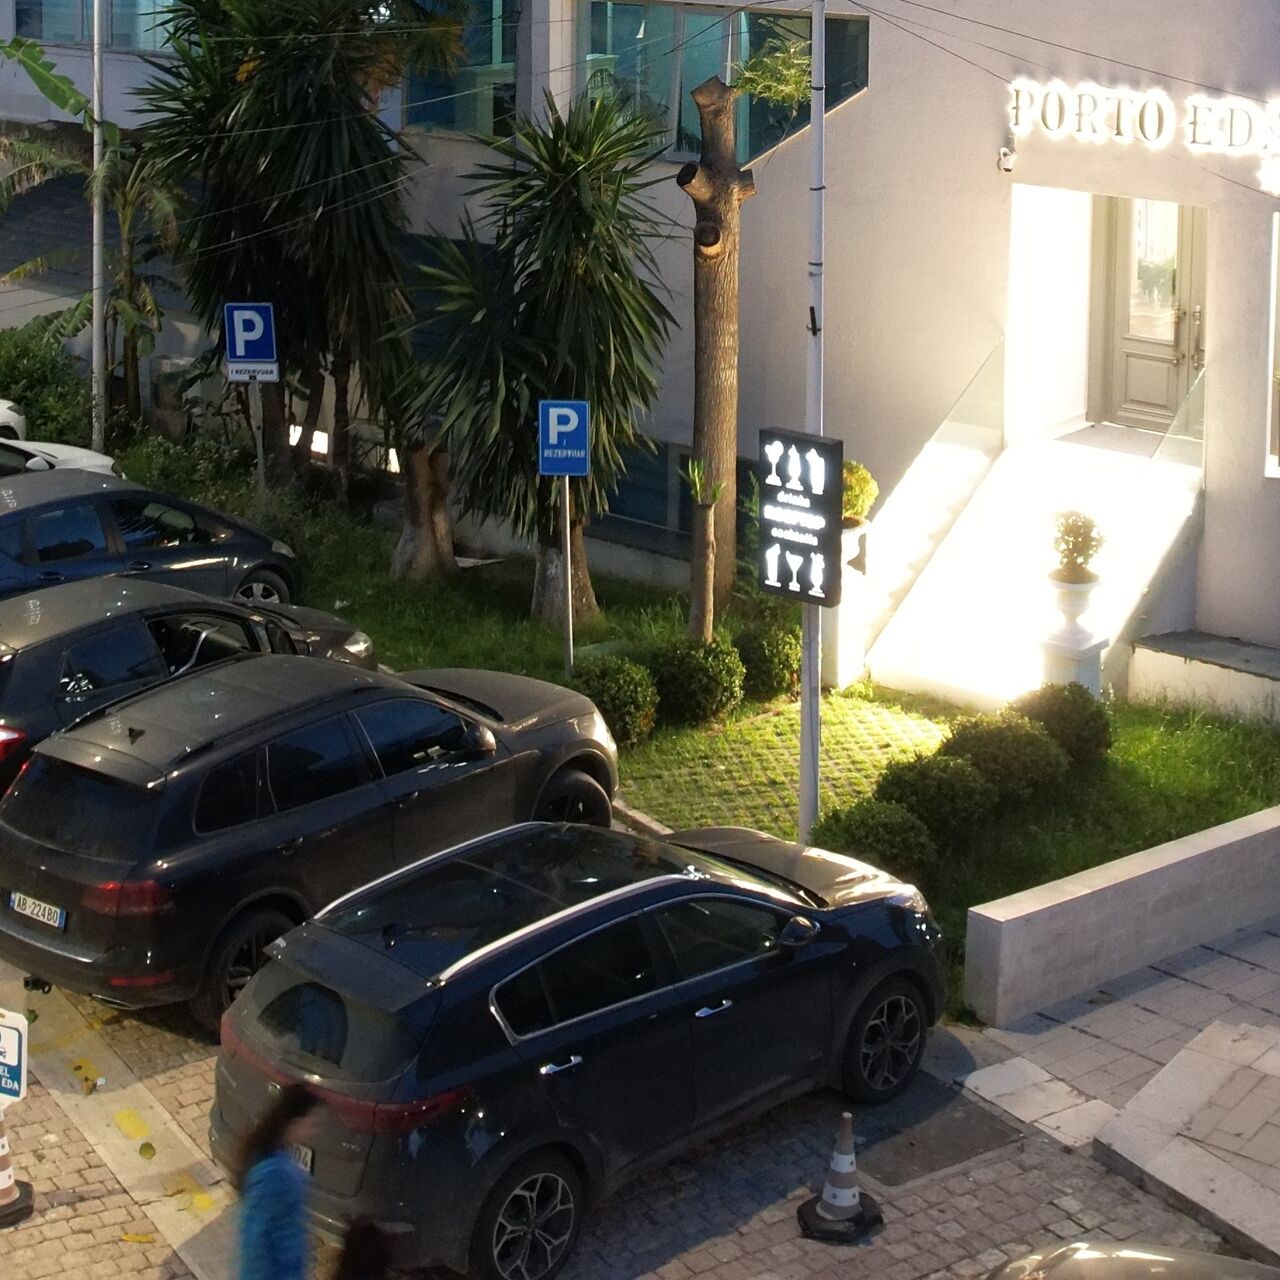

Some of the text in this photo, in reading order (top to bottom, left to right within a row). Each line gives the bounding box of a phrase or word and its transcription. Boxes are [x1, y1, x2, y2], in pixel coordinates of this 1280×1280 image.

[1011, 85, 1167, 144] PORTO
[233, 310, 264, 356] P
[549, 407, 579, 445] P
[1, 1077, 20, 1092] EDA
